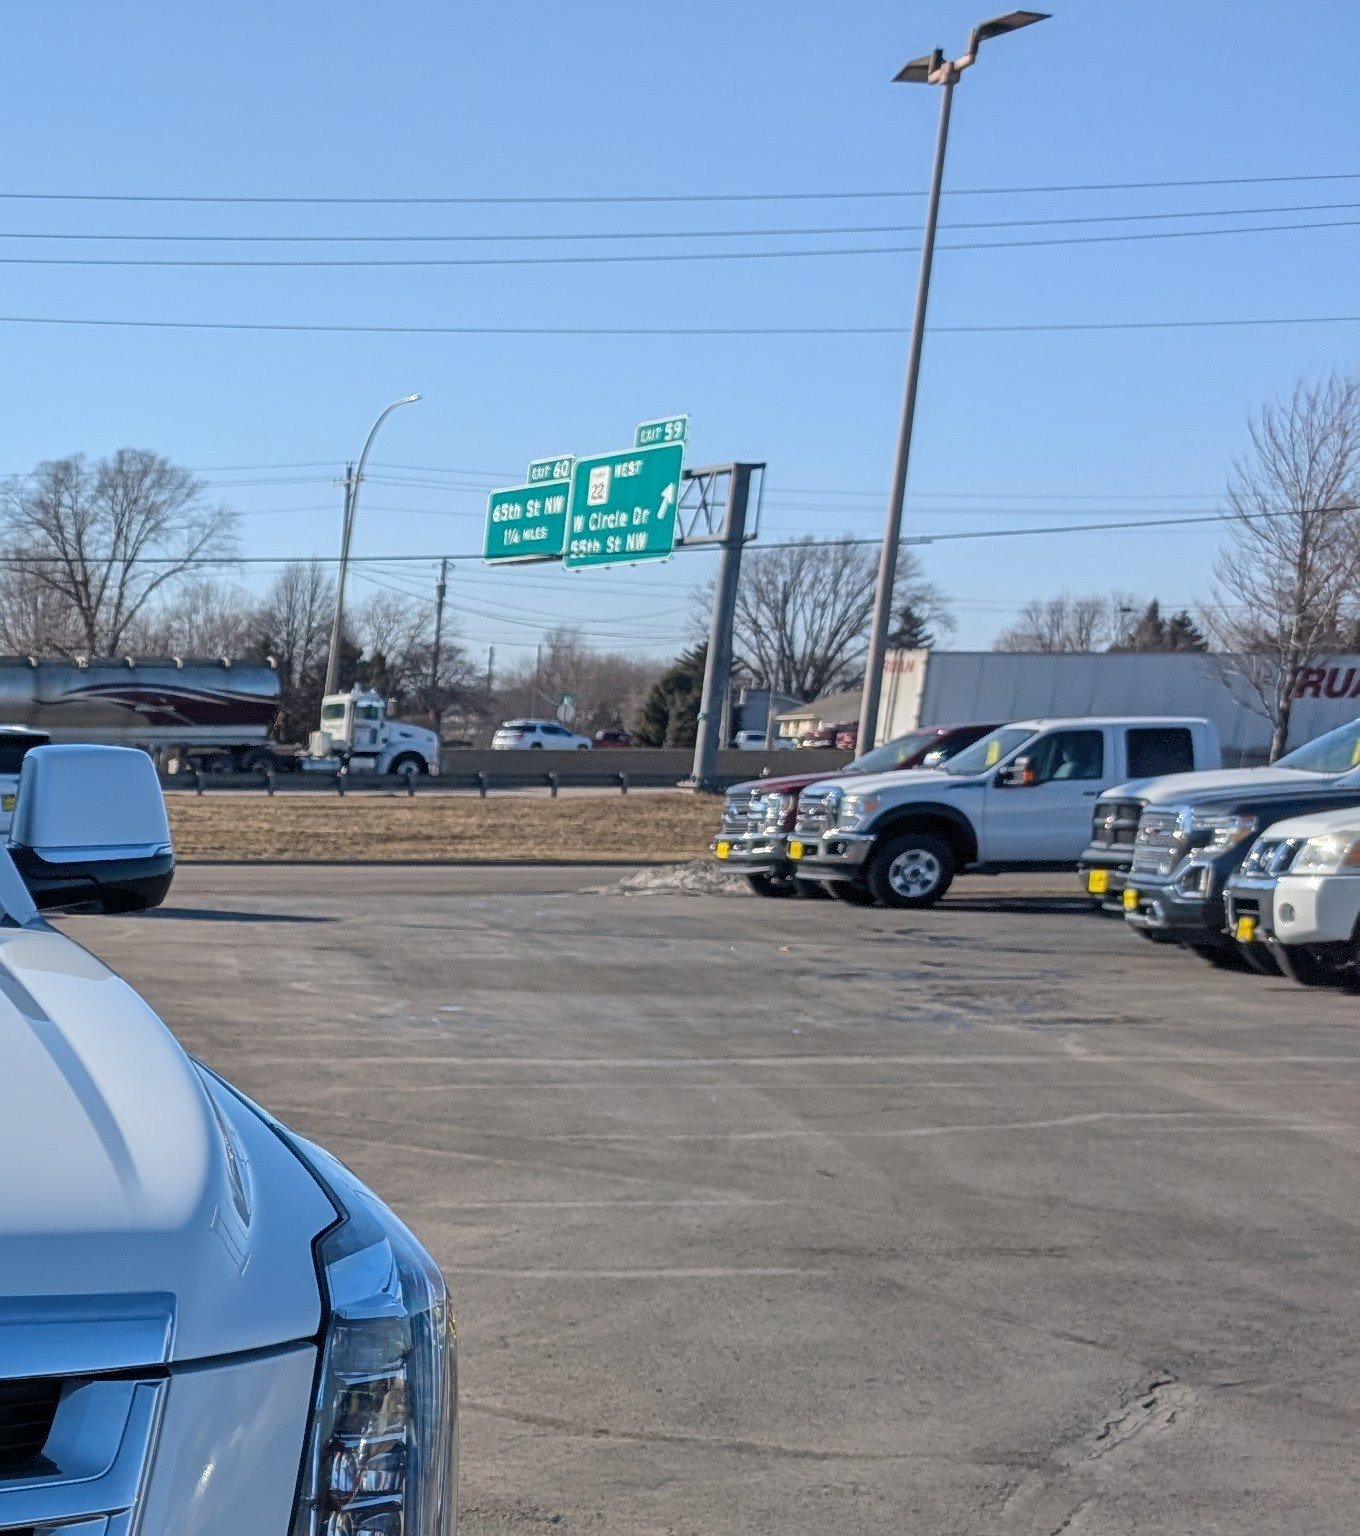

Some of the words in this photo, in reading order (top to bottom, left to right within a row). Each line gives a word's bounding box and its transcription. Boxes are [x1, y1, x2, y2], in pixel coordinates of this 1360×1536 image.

[664, 421, 683, 440] 59
[553, 460, 569, 478] 60
[591, 482, 605, 500] 22
[614, 460, 643, 478] WEST
[493, 502, 522, 522] 65th
[526, 499, 541, 518] St
[544, 495, 565, 515] NW
[573, 515, 585, 533] W
[589, 510, 628, 531] Circle
[633, 506, 650, 525] Dr
[569, 538, 601, 559] 55th
[606, 535, 621, 553] St
[626, 531, 648, 552] NW
